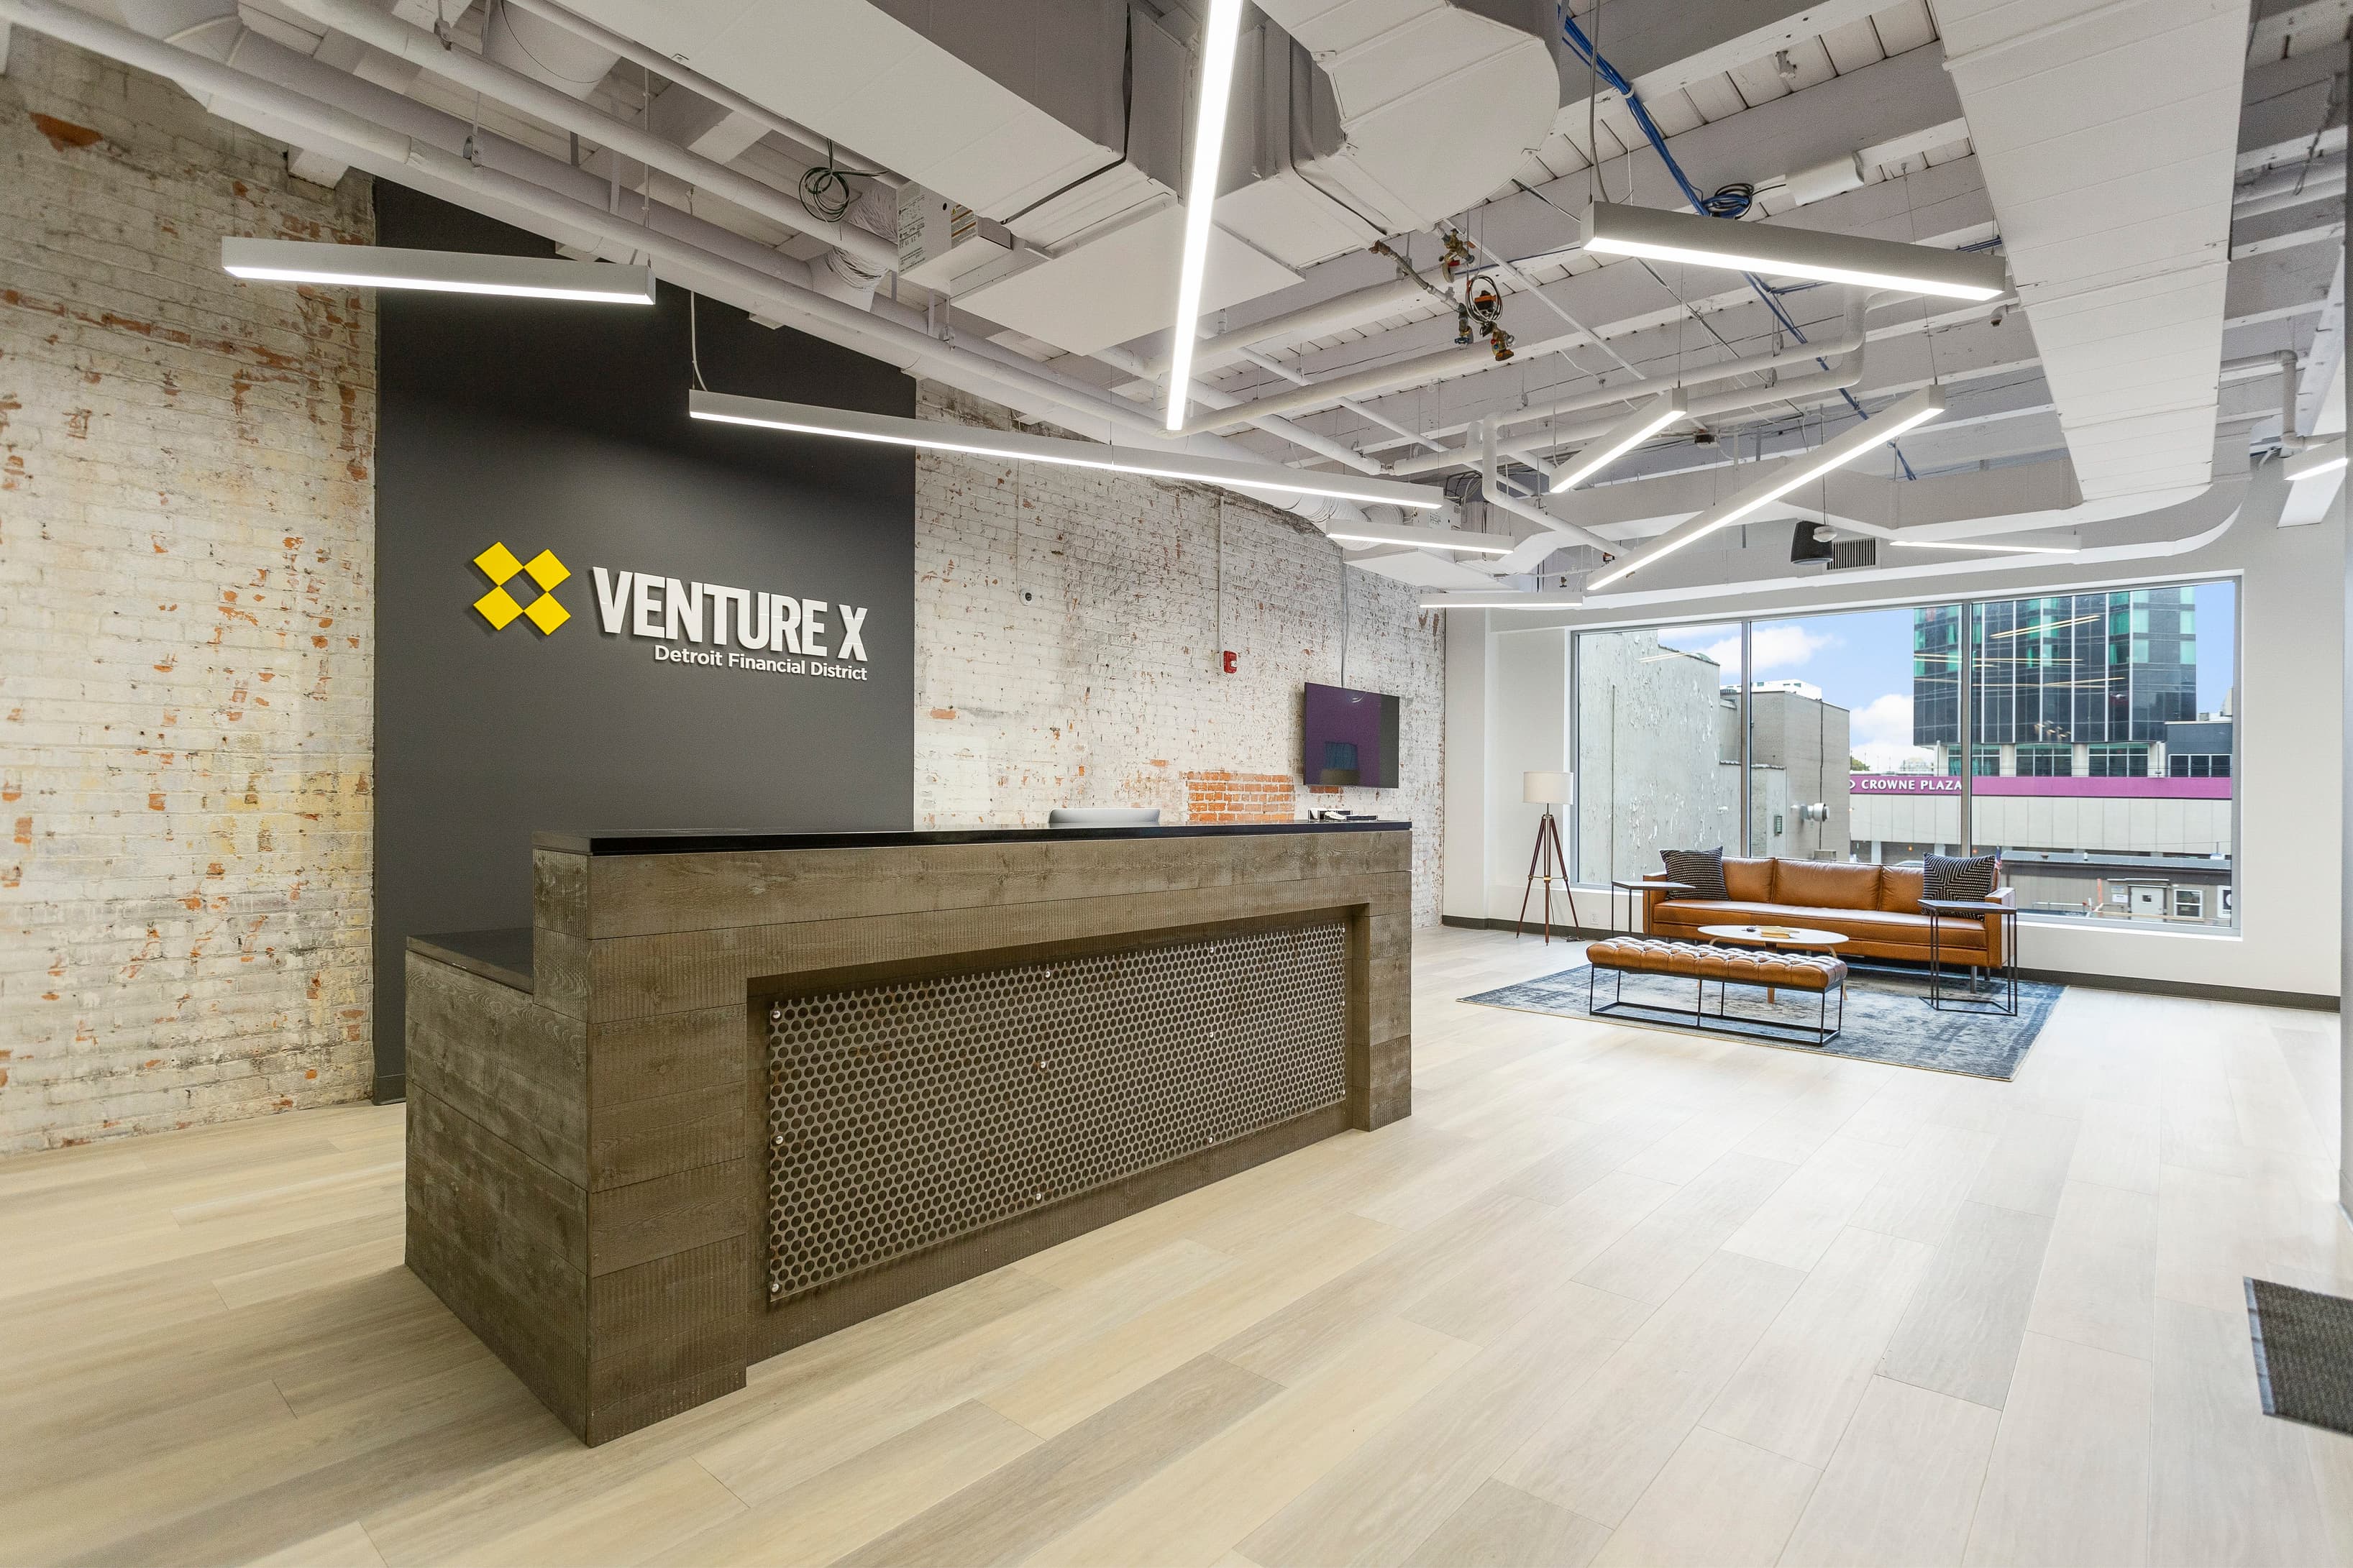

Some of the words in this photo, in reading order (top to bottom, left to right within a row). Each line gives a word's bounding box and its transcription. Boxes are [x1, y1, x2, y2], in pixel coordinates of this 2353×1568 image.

[593, 567, 828, 657] VENTURE
[837, 604, 868, 661] X
[654, 645, 723, 666] Detroit
[728, 653, 805, 675] Financial
[810, 661, 867, 681] District
[1861, 779, 1915, 789] CROWNE
[1920, 779, 1962, 790] PLAZA
